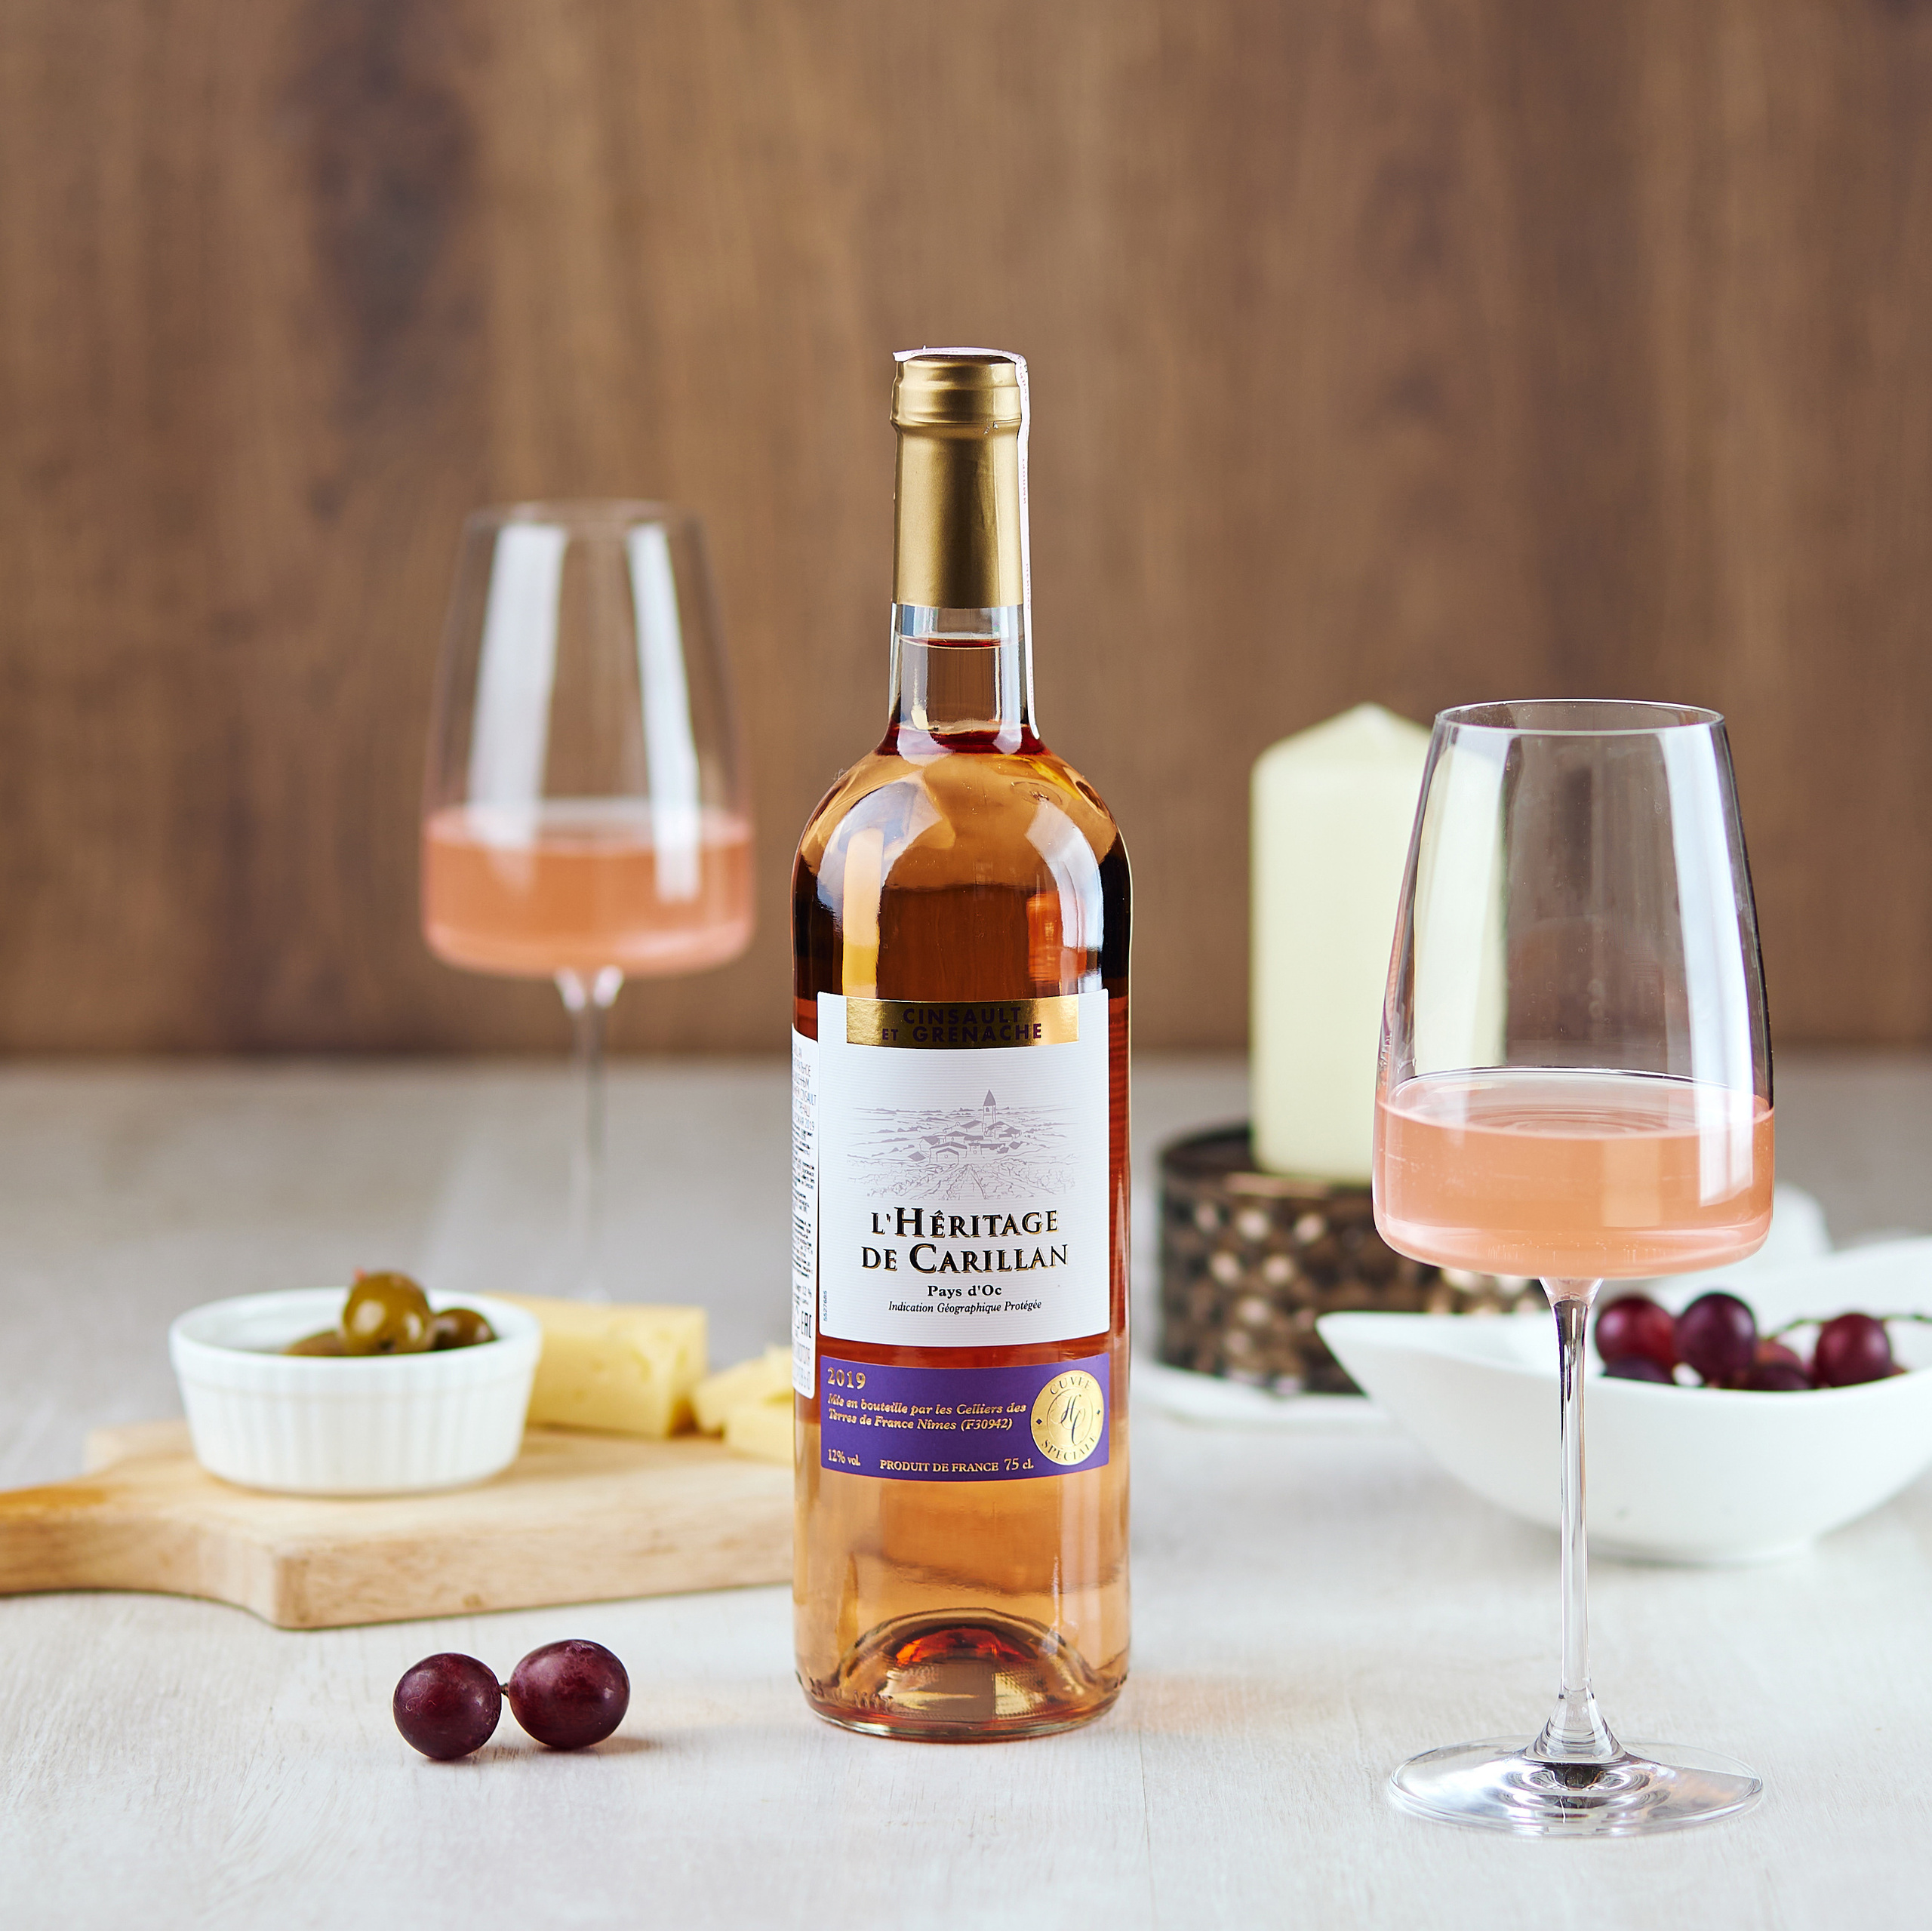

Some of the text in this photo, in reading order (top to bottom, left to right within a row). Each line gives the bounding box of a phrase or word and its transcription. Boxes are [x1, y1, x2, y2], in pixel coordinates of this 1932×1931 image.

[903, 1007, 1021, 1025] CINSAULT
[882, 1023, 1042, 1042] ET GRENACHE
[861, 1243, 1068, 1274] DE CARILLAN
[928, 1284, 1002, 1299] Pays d'Oc
[888, 1299, 1042, 1315] Indication Géographique Protégée
[827, 1367, 866, 1390] 2019
[827, 1393, 1027, 1416] Mis en bouteille par les Celliers des
[828, 1408, 1013, 1432] Terres de France Nîmes (F30942)
[828, 1449, 846, 1464] 12%
[879, 1459, 931, 1472] PRODUIT
[932, 1462, 949, 1472] DE
[952, 1462, 999, 1472] FRANCE
[1004, 1457, 1020, 1471] 75
